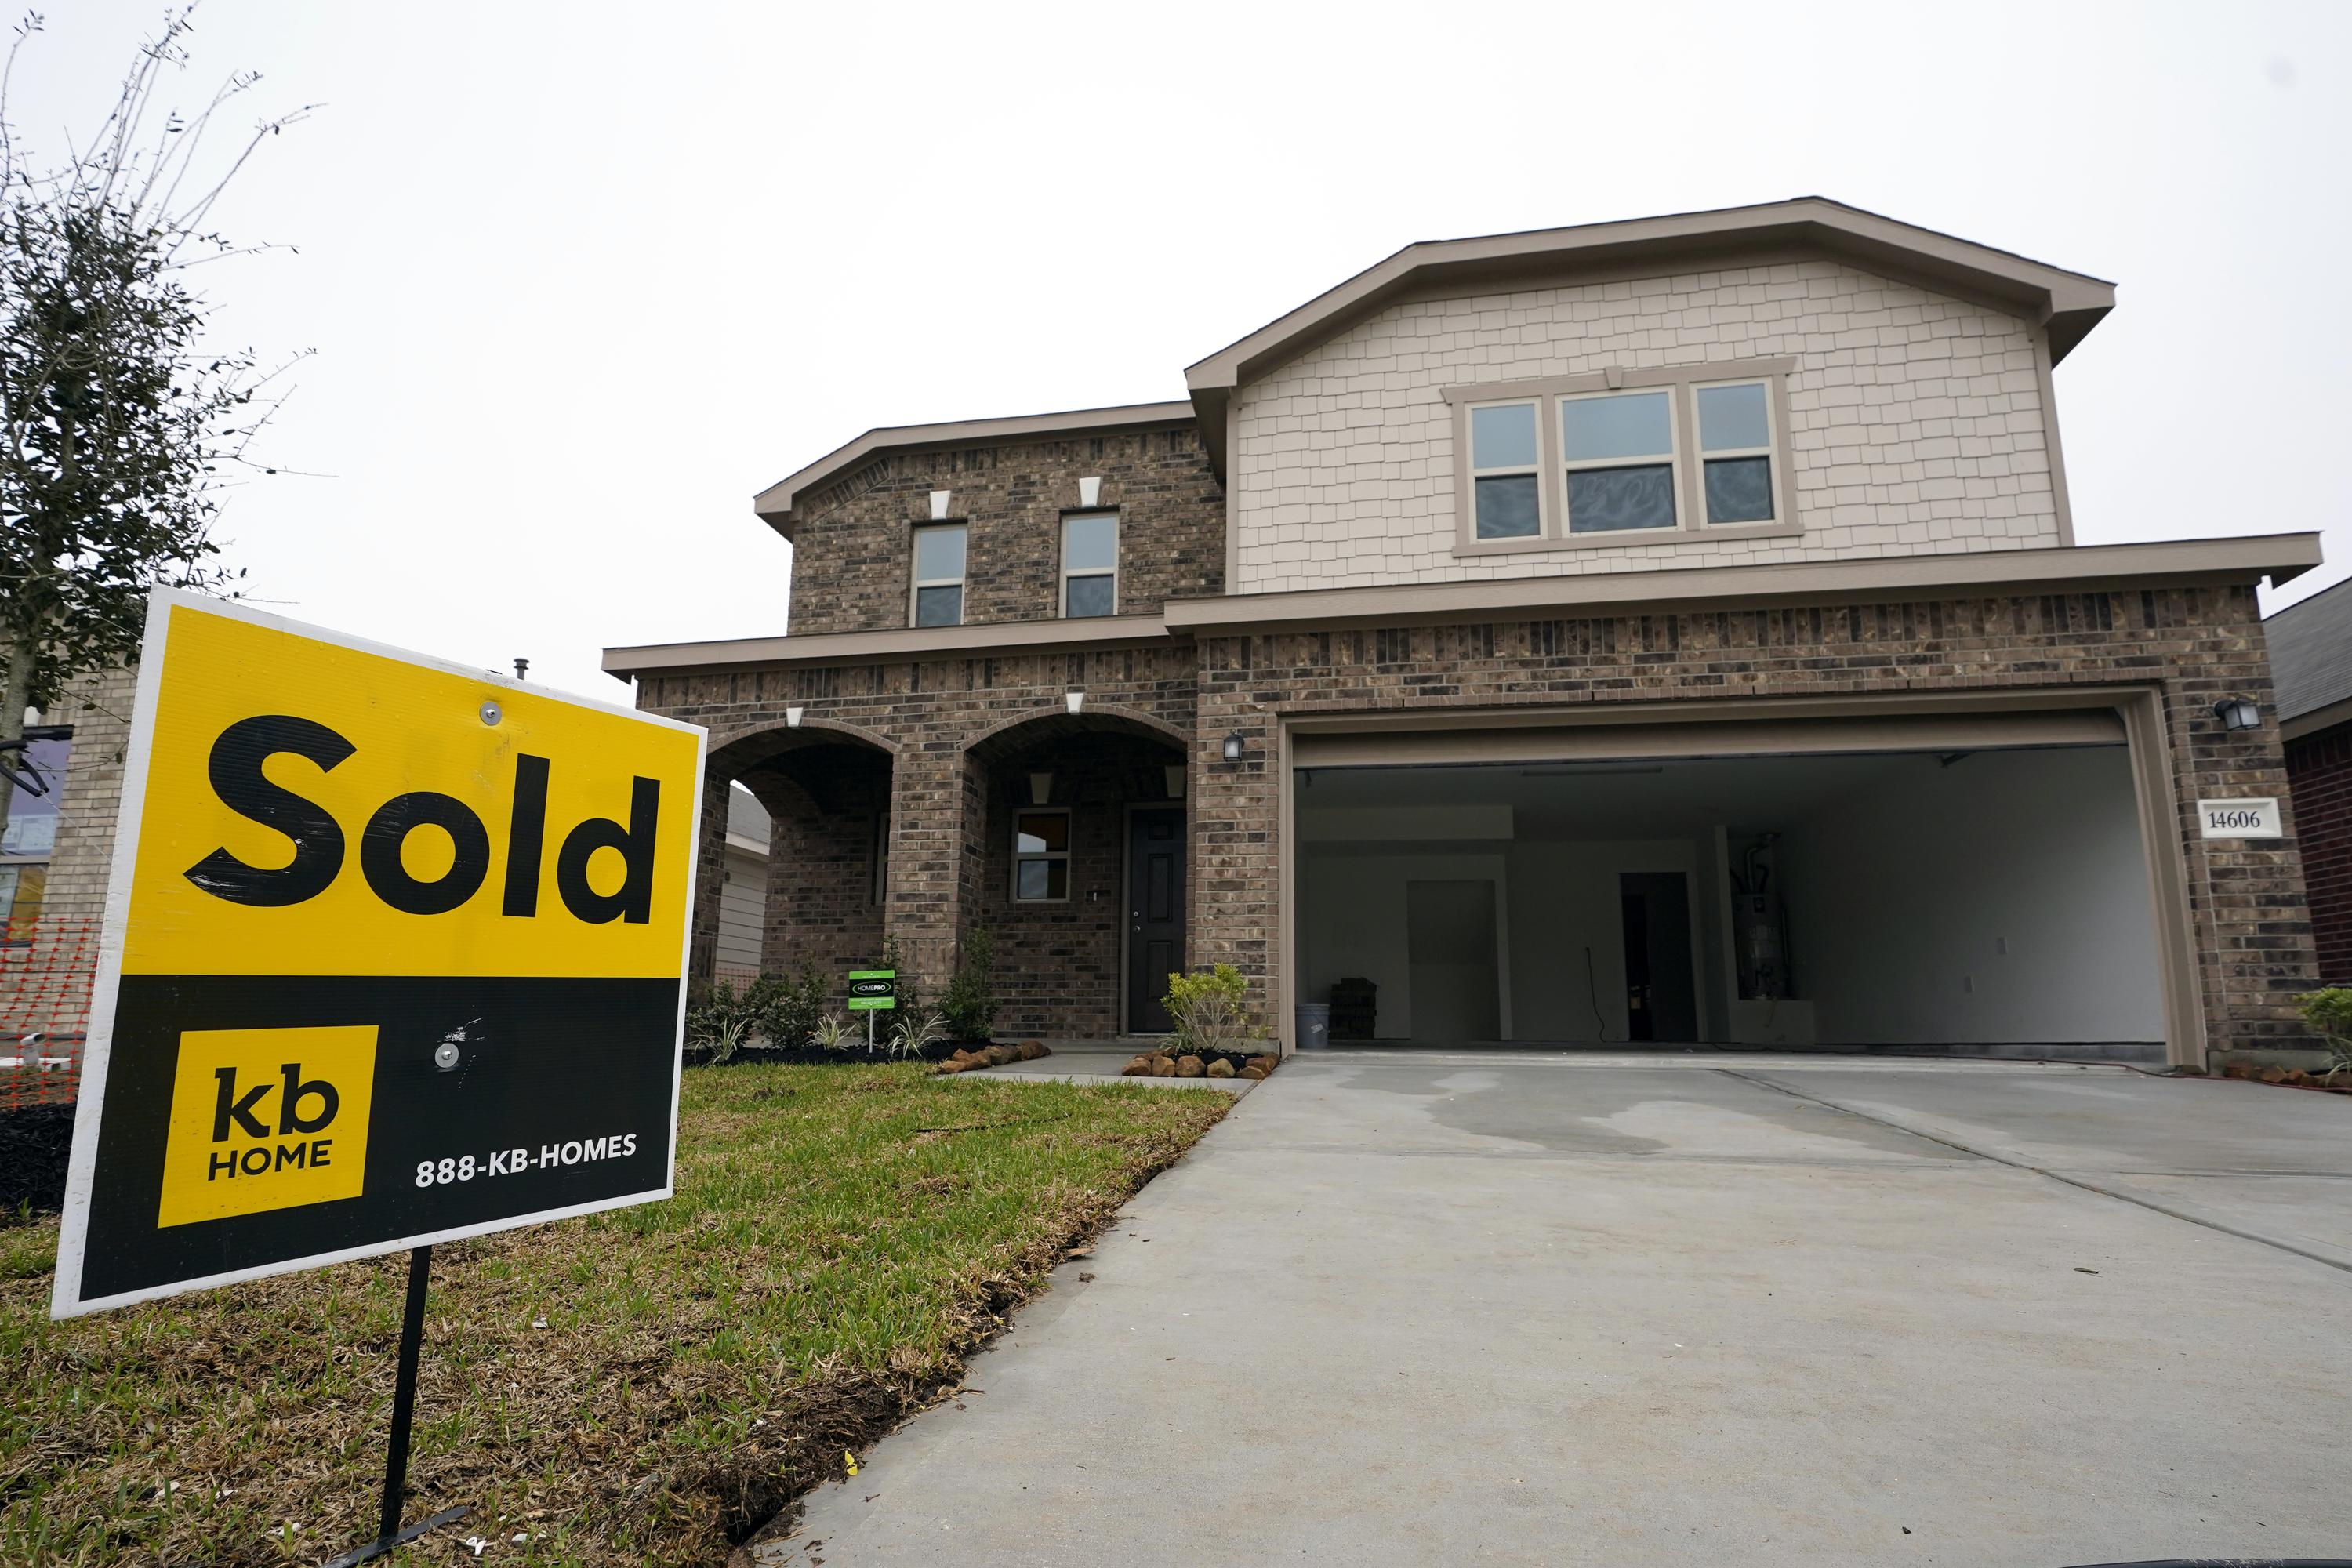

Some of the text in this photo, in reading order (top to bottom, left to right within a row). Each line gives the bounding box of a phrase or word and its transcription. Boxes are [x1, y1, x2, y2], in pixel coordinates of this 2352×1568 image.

[183, 714, 661, 925] Sold
[2208, 811, 2261, 829] 14606
[212, 1062, 339, 1143] kb
[207, 1139, 333, 1181] HOME
[415, 1133, 637, 1188] 888-KB-HOMES
